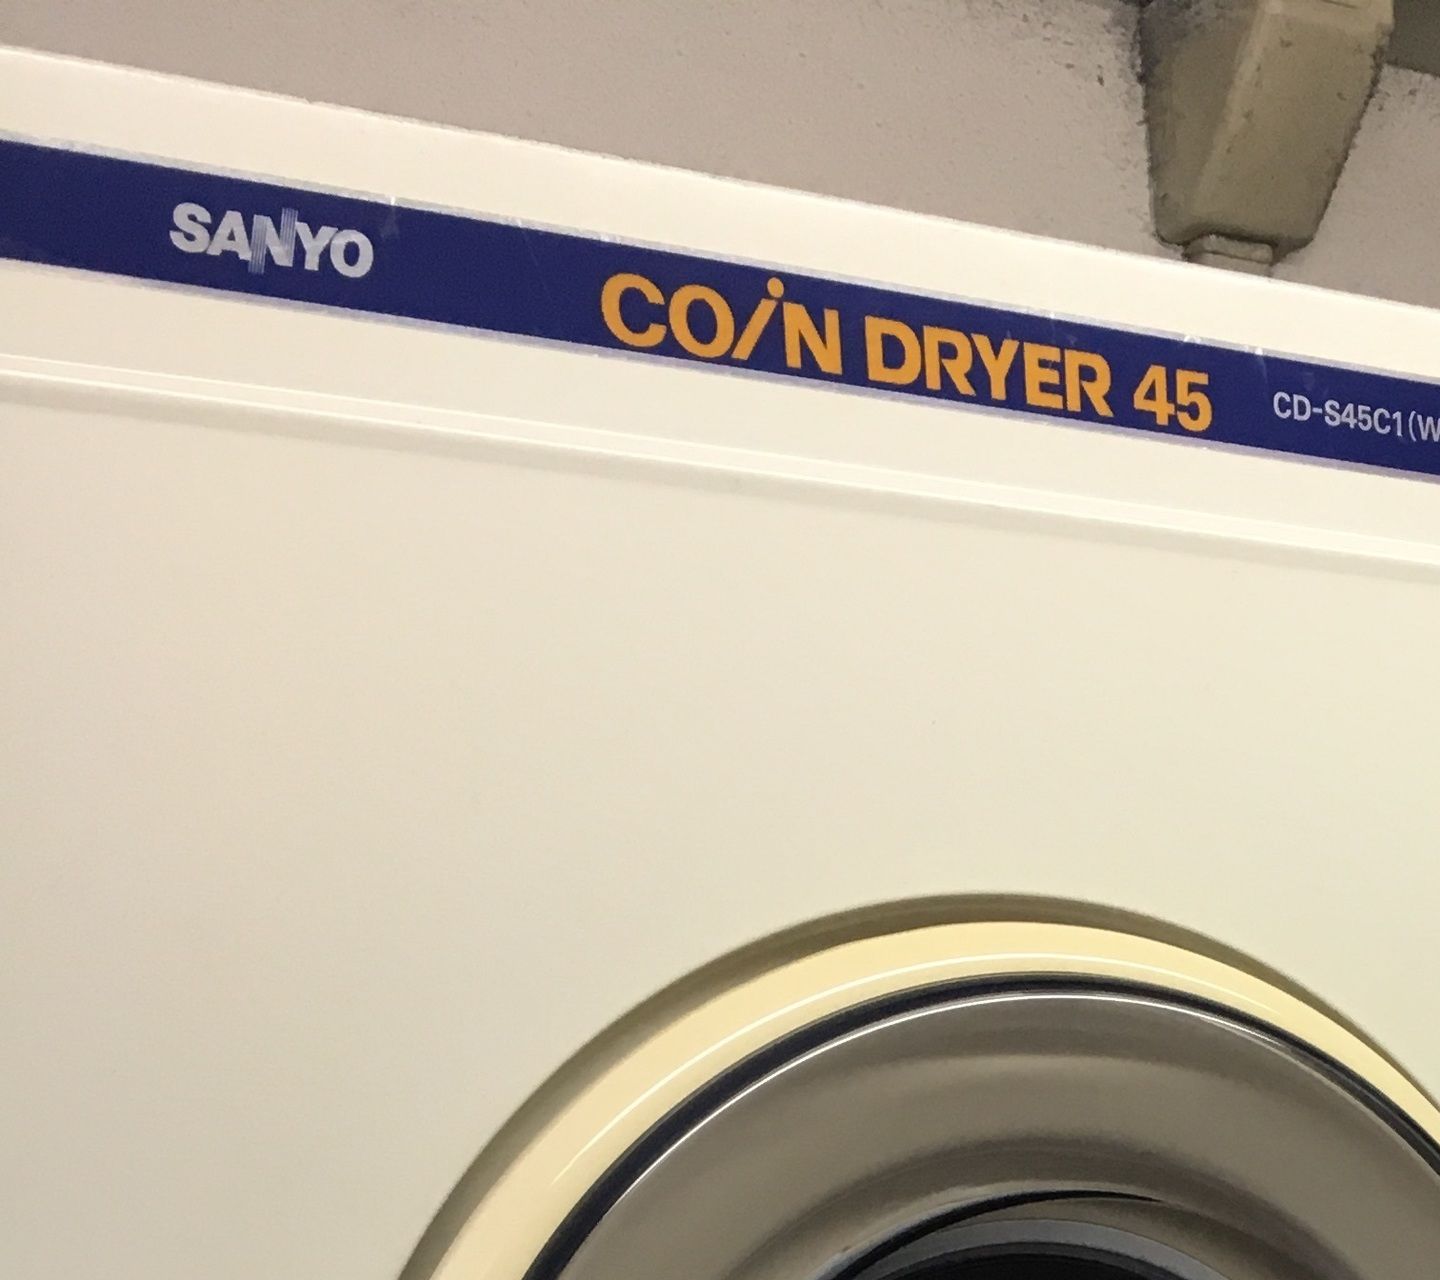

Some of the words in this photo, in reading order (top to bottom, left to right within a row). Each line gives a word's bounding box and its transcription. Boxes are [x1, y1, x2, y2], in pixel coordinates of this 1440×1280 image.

[171, 202, 373, 276] SANYO
[864, 314, 1113, 418] DRYER
[1132, 363, 1213, 432] 45
